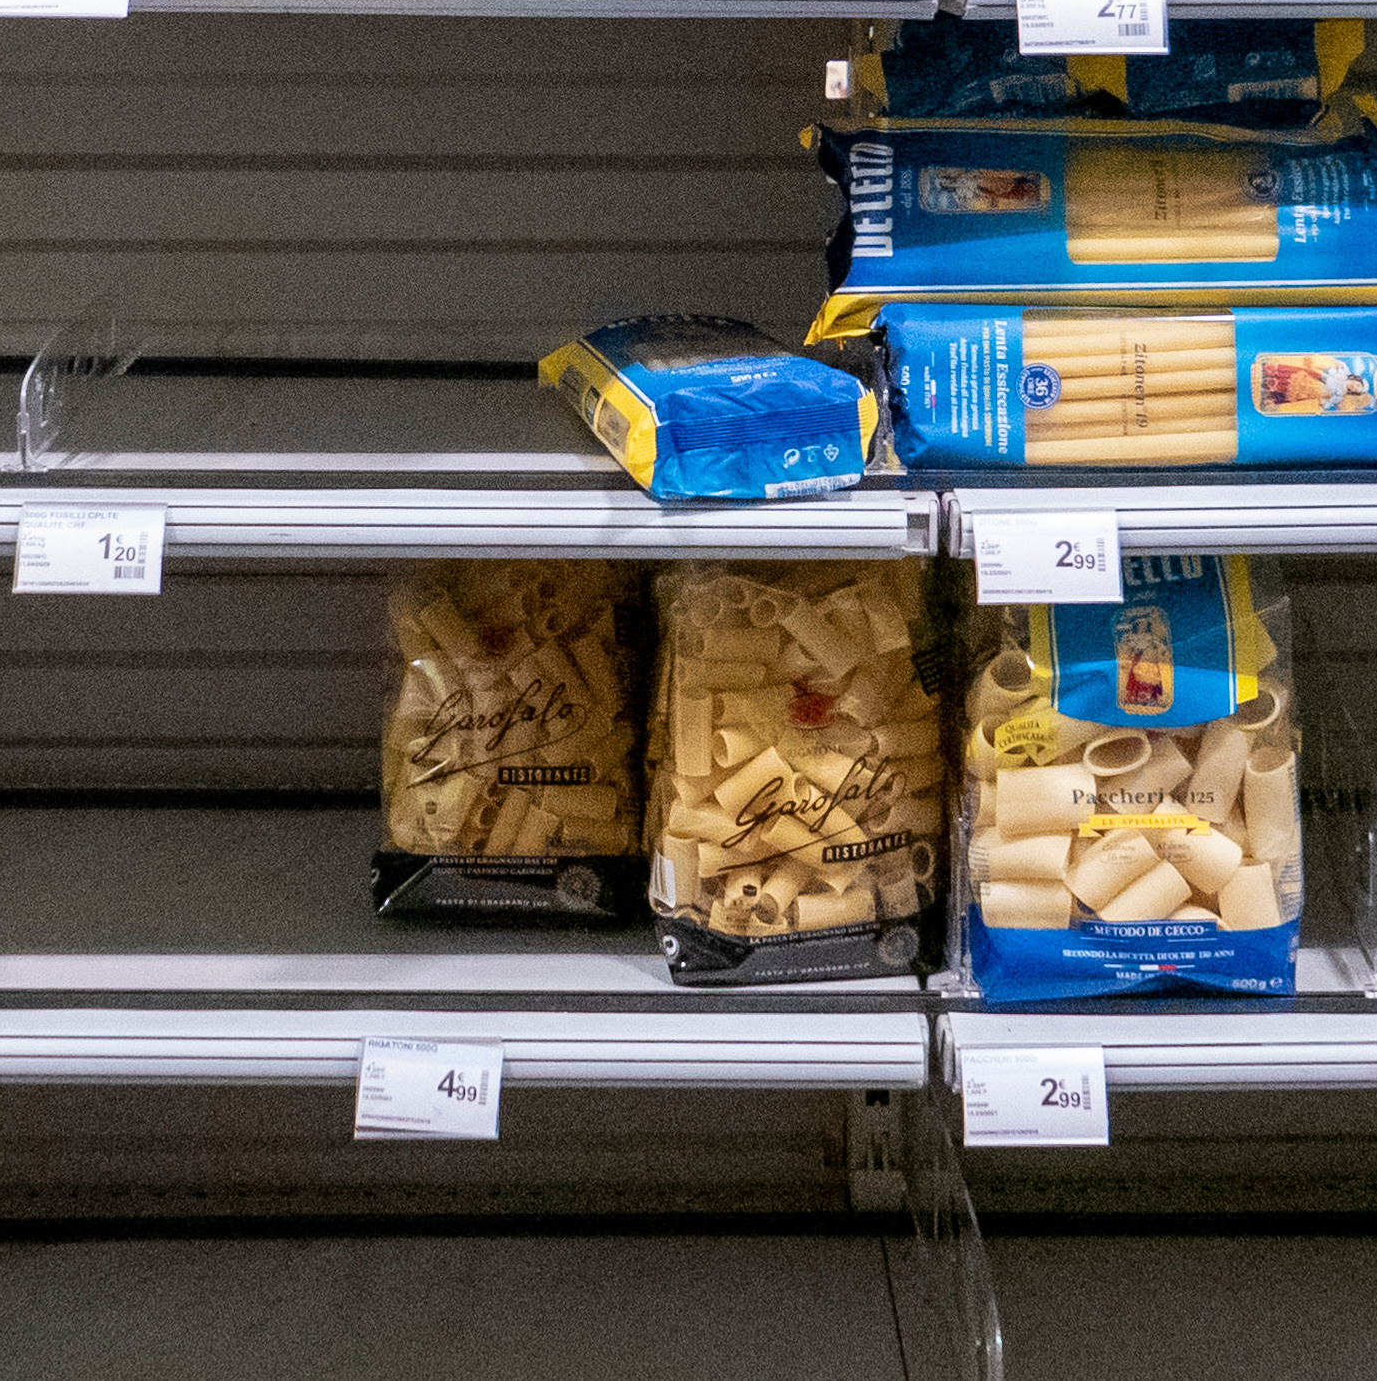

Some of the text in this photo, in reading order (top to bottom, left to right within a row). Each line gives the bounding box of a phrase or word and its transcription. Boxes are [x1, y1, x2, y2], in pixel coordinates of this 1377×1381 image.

[994, 320, 1012, 455] Lenta Essiccazione
[1035, 377, 1049, 397] 36
[50, 511, 86, 519] FUSILLI
[87, 511, 119, 519] CPLTE
[978, 518, 1012, 526] ZITONE
[411, 679, 588, 764] Garofalo
[501, 768, 590, 784] RISTORANTE
[721, 756, 907, 849] Garofalo
[1071, 788, 1215, 805] Paccheri 125
[824, 834, 910, 861] RISTORANTE
[1094, 925, 1204, 937] METODO DE CECCO
[1063, 949, 1105, 958] SECONDO
[1105, 950, 1117, 958] LA
[1117, 951, 1155, 960] RICETTA
[367, 1039, 414, 1050] RIGATONI
